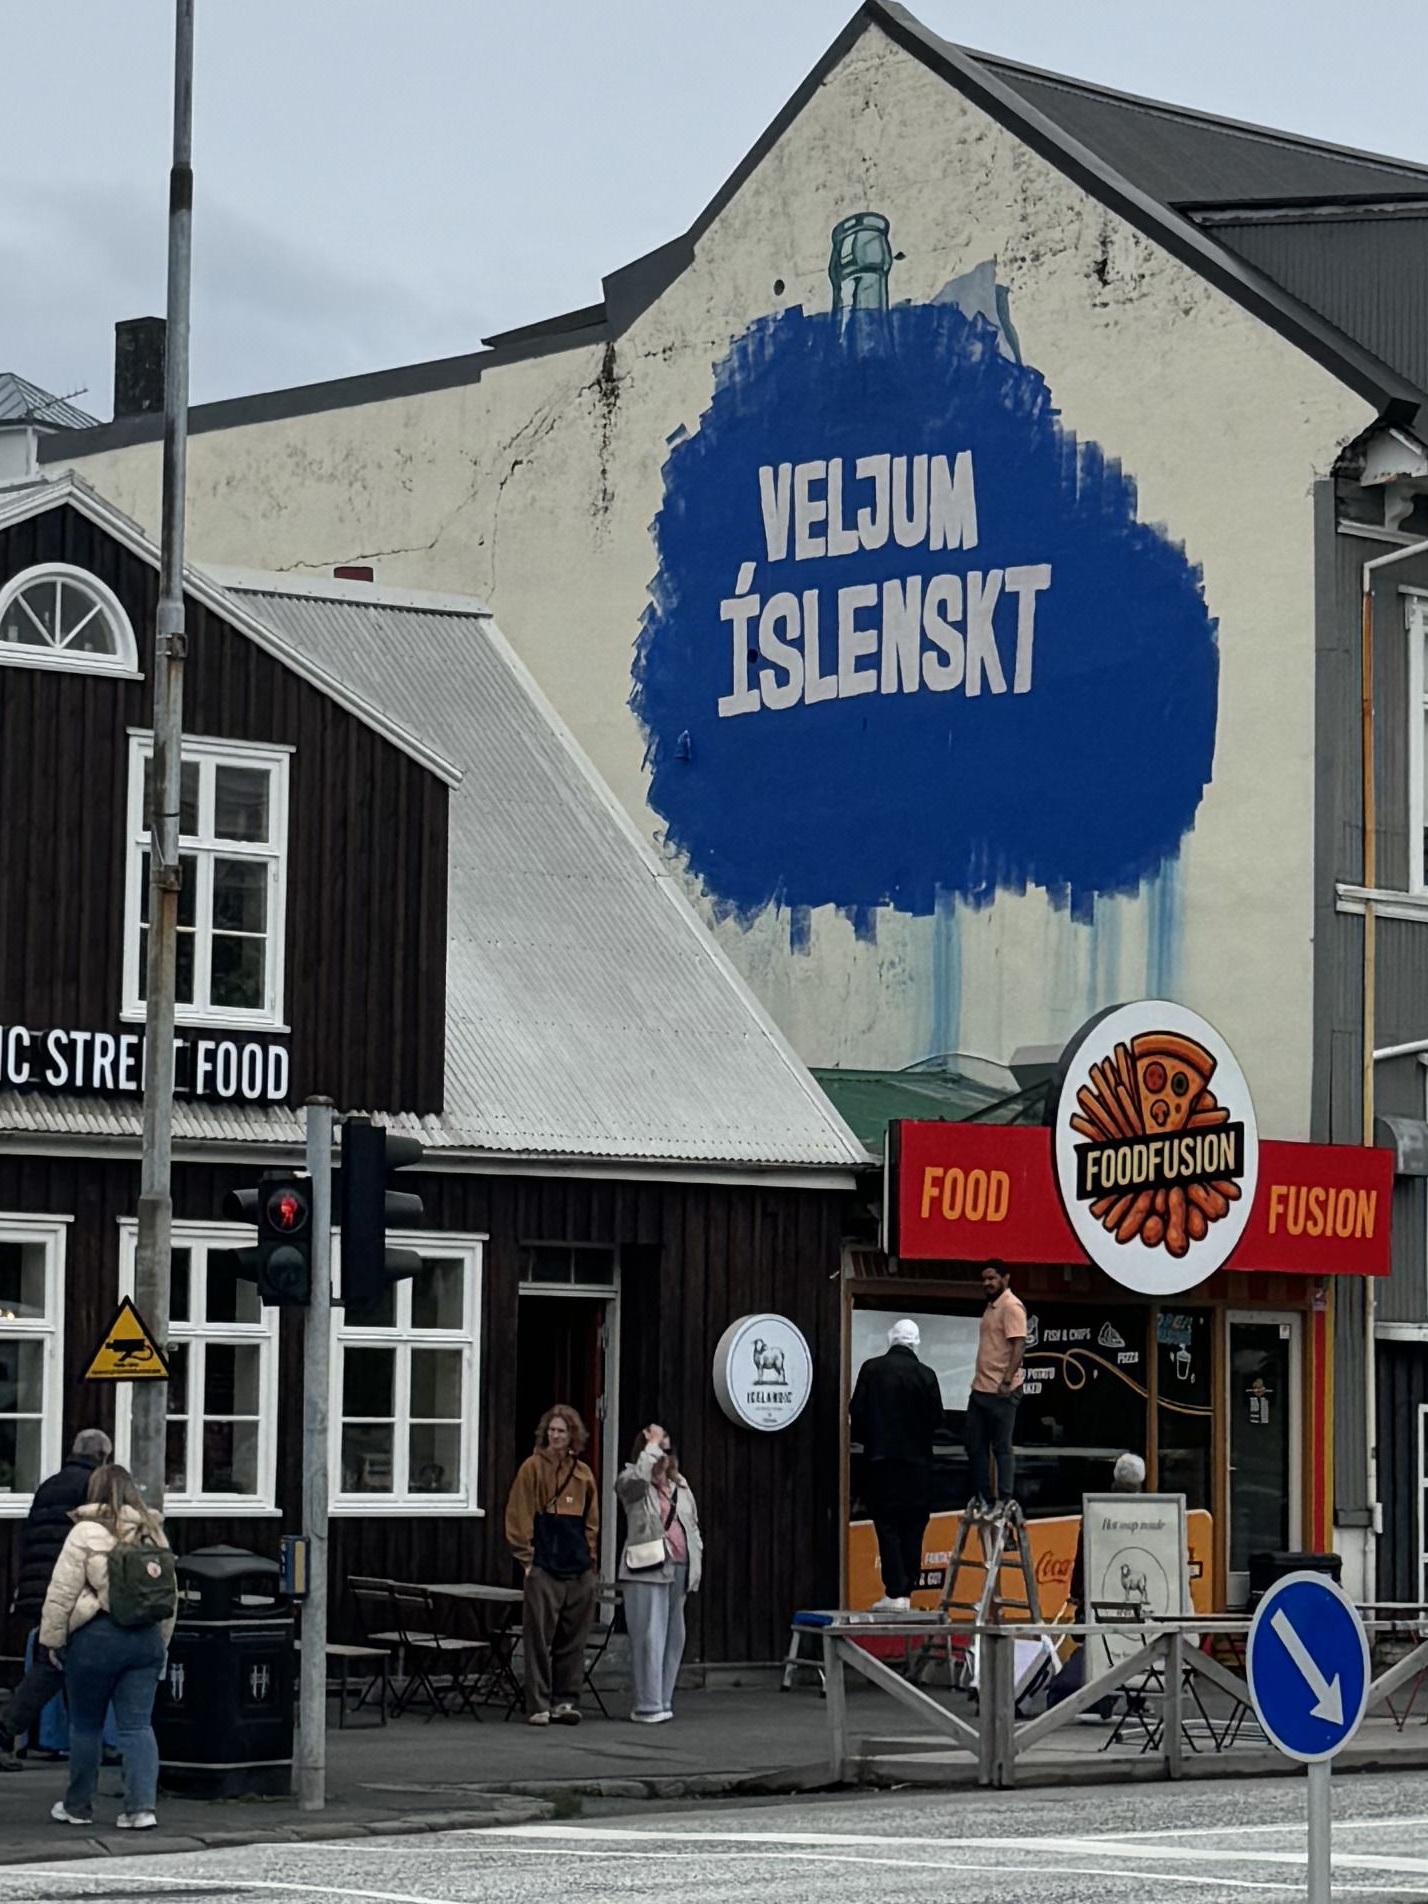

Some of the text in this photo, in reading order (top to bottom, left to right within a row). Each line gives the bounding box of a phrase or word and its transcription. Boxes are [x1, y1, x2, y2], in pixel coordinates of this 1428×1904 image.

[759, 450, 979, 562] VELJUM
[718, 562, 1052, 717] ÍSLENSKT
[45, 1028, 184, 1093] STRET
[196, 1039, 290, 1100] FOOD
[1085, 1129, 1236, 1192] FOODFUSION
[920, 1166, 1010, 1222] FOOD
[1268, 1185, 1377, 1239] FUSION
[1043, 1328, 1061, 1342] FISH
[1069, 1327, 1091, 1341] CHIPS
[1117, 1352, 1139, 1364] PIZZA
